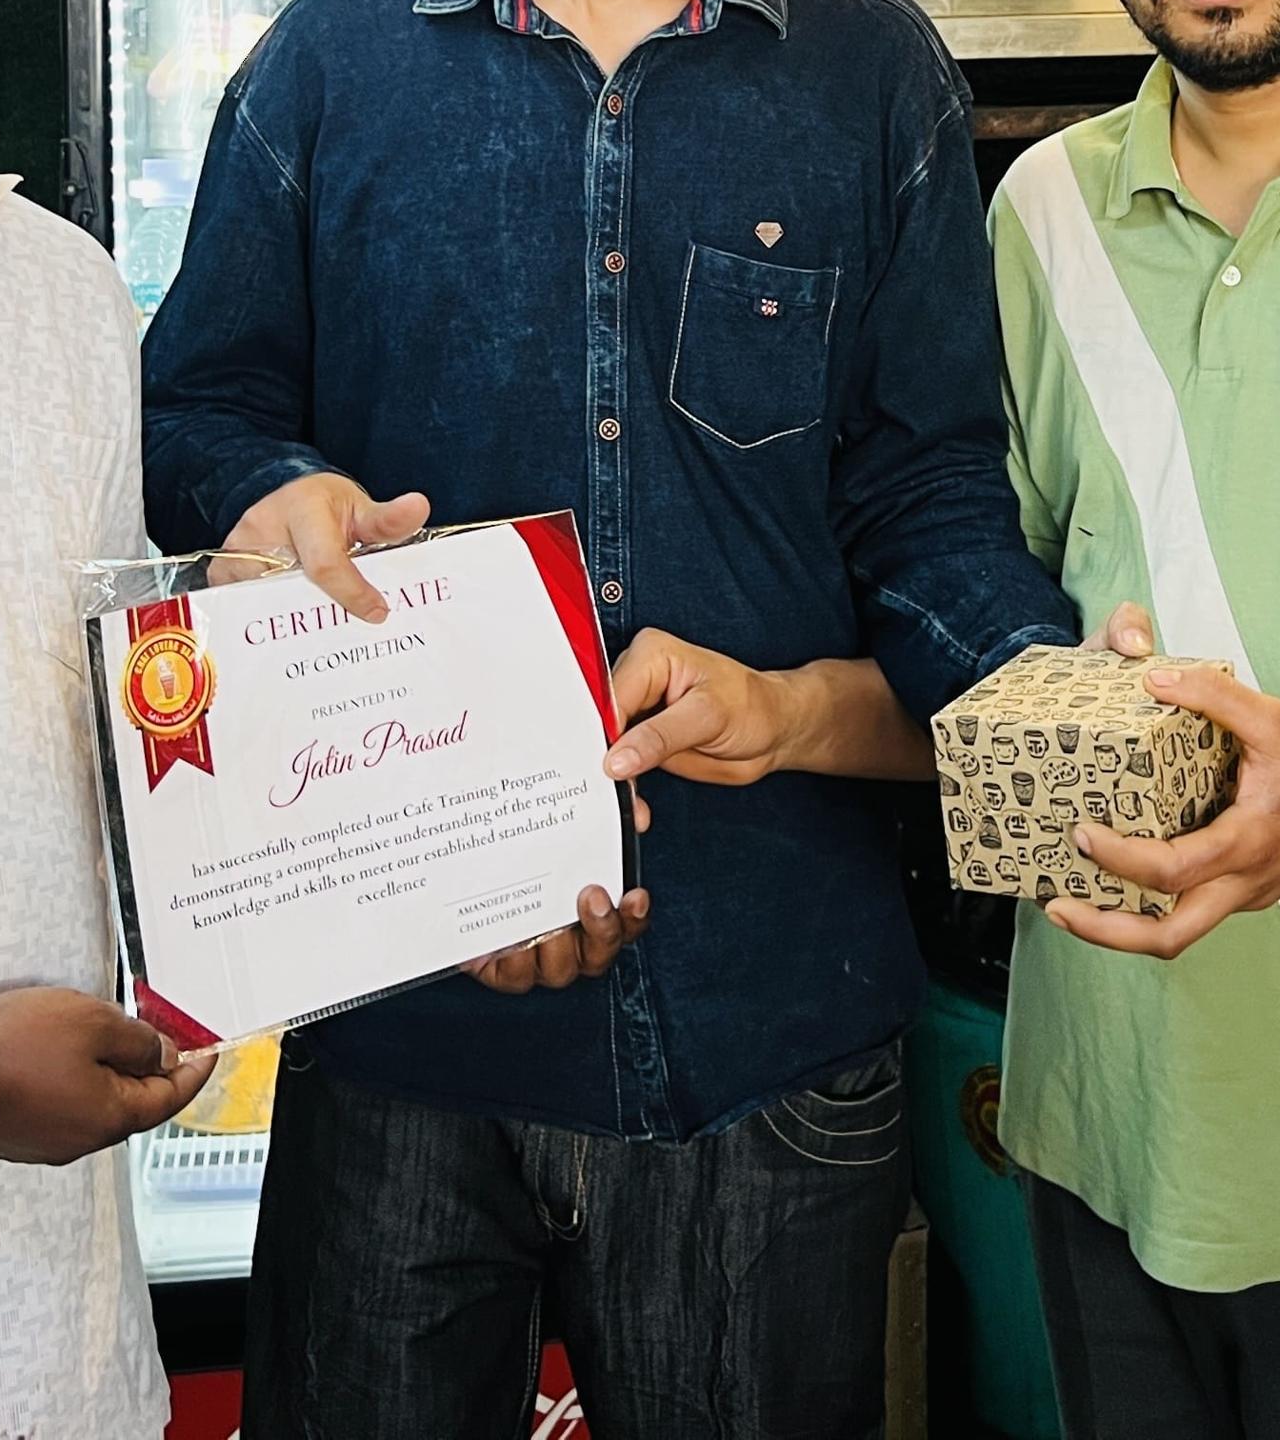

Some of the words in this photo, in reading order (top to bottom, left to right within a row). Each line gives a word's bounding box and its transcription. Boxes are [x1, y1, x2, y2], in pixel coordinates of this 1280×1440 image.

[244, 576, 453, 646] CERTIATE
[285, 659, 310, 679] OF
[313, 632, 427, 673] COMPLETION
[311, 691, 386, 721] PRESENTED
[363, 710, 469, 767] Prasad
[170, 871, 273, 911] demonstrating
[276, 869, 284, 879] a
[287, 836, 390, 876] comprehensive
[395, 811, 492, 846] understanding
[494, 800, 510, 816] of
[511, 798, 532, 813] the
[535, 779, 588, 807] required
[192, 862, 216, 879] has
[219, 837, 297, 870] successfully
[301, 813, 372, 848] completed
[376, 811, 400, 826] our
[403, 797, 434, 818] Cafe
[437, 784, 499, 809] Training
[193, 897, 271, 930] knowledge
[275, 884, 301, 905] and
[304, 875, 338, 896] skills
[341, 873, 356, 885] to
[360, 862, 394, 880] meet
[397, 854, 421, 869] our
[424, 829, 496, 861] established
[498, 813, 559, 841] standards
[562, 805, 577, 822] of
[357, 877, 428, 905] excellence
[457, 893, 511, 917] AMANDEEP
[512, 882, 543, 900] SINGH
[459, 919, 484, 934] CHAI
[485, 909, 522, 926] LOVERS
[523, 900, 543, 913] BAR
